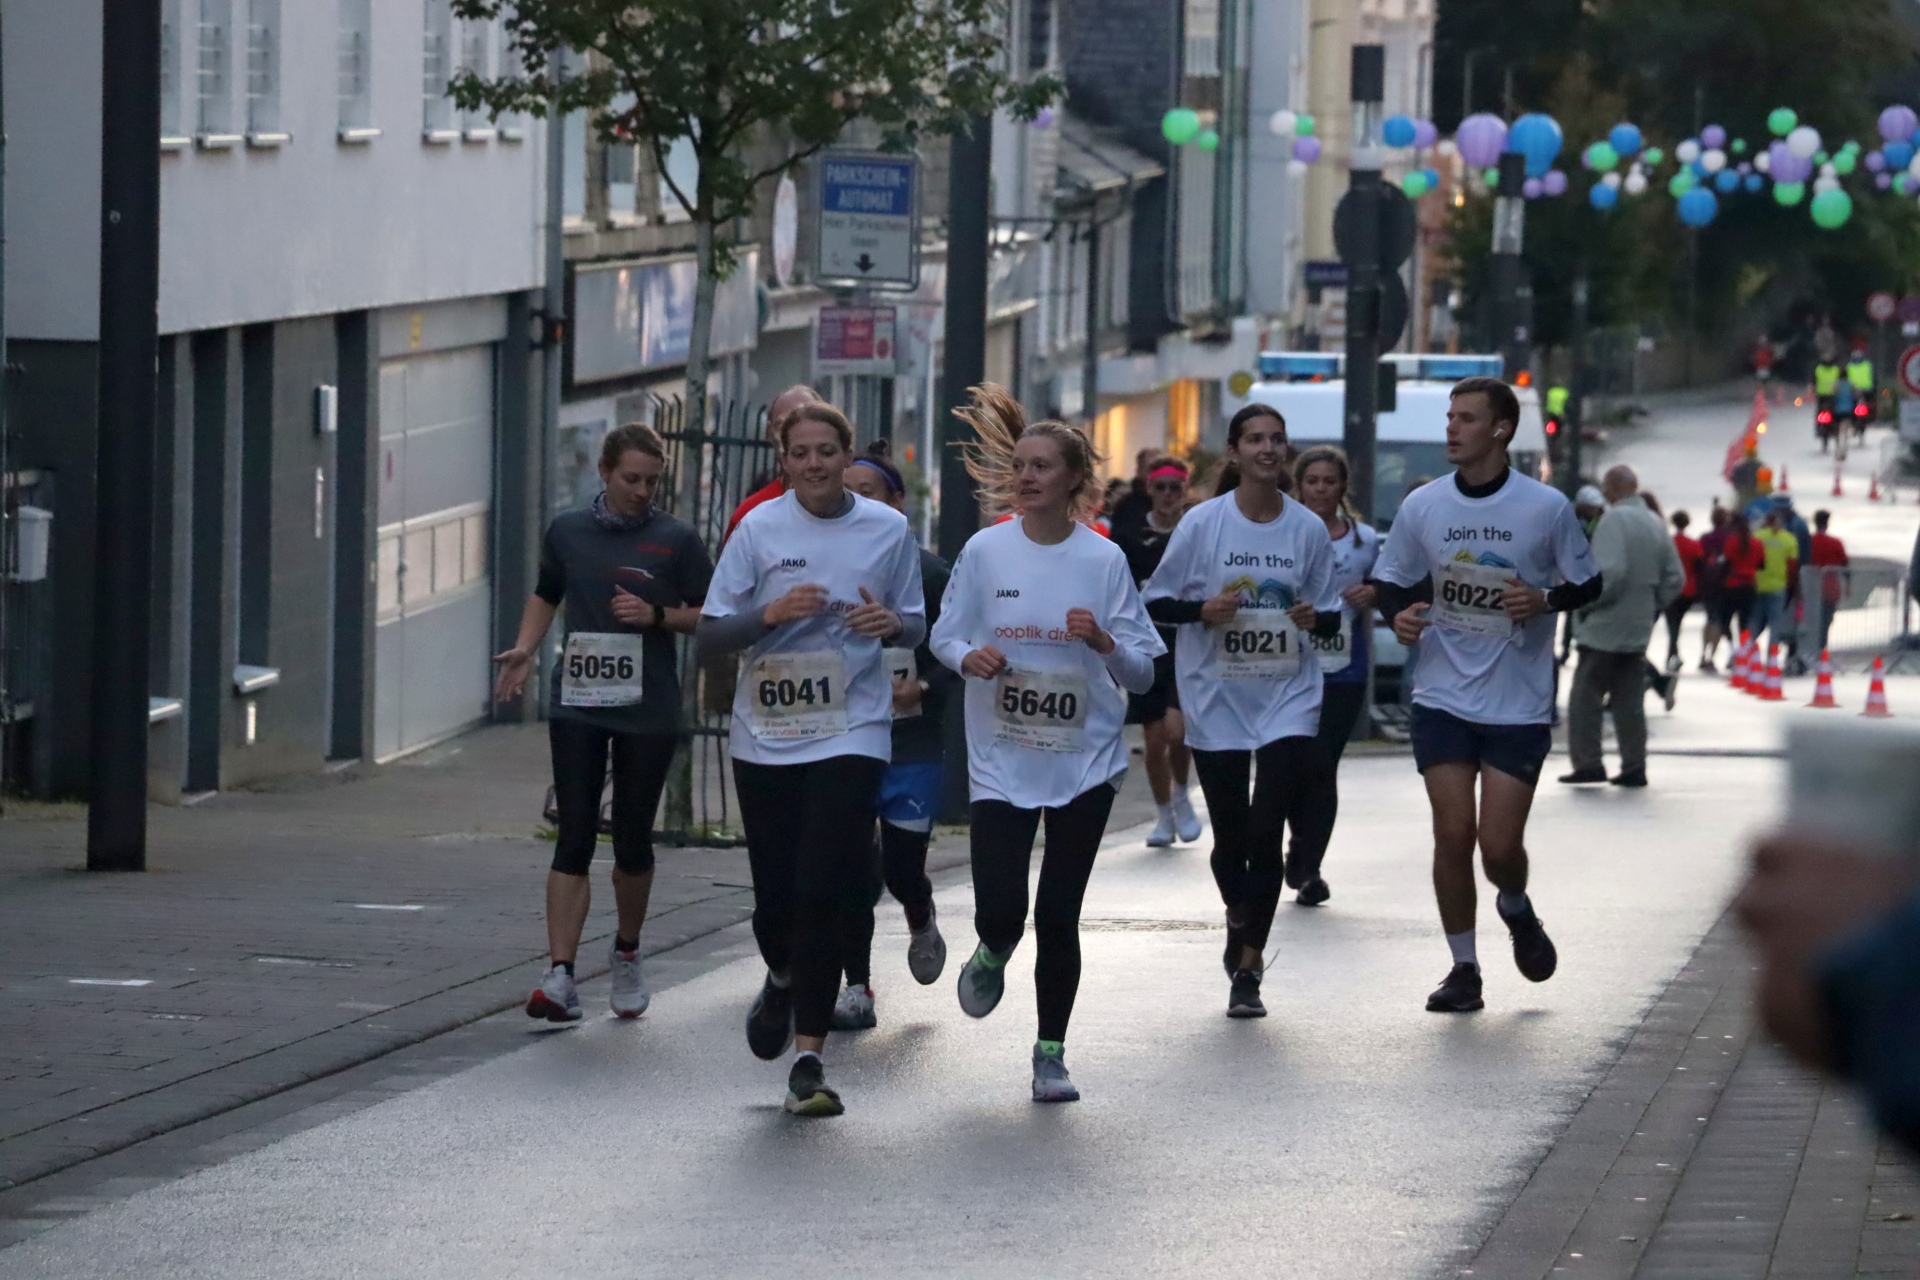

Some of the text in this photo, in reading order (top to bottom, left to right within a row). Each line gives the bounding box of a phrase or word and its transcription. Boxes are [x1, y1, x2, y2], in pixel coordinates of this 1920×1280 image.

[838, 188, 894, 210] AUTOMAT
[1443, 526, 1513, 542] Join the
[780, 558, 806, 568] JAKO
[1224, 551, 1294, 569] Join the
[995, 589, 1020, 598] JAKO
[1442, 579, 1505, 611] 6022
[830, 600, 860, 613] dre
[1224, 629, 1287, 654] 6021
[569, 654, 634, 680] 5056
[759, 676, 831, 707] 6041
[1002, 685, 1077, 721] 5640
